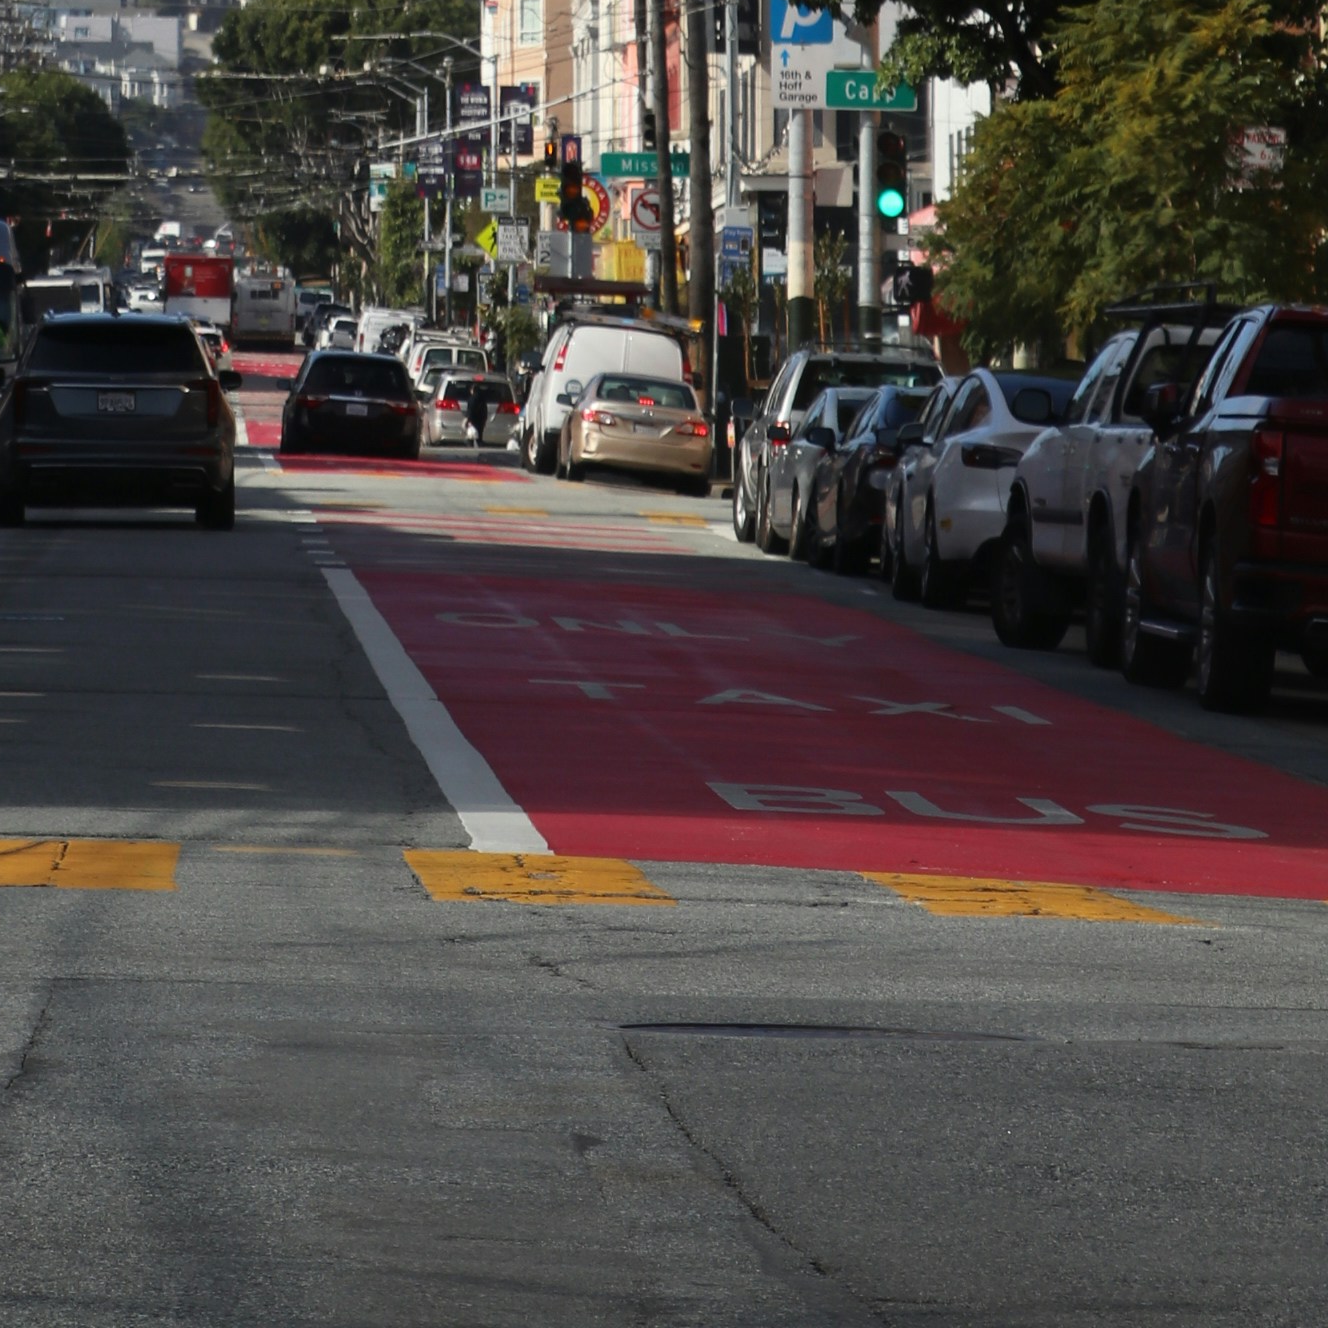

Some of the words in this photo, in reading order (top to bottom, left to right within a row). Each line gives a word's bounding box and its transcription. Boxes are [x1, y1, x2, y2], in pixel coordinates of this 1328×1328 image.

[778, 81, 803, 91] Hoff
[779, 70, 802, 81] 16th
[804, 71, 812, 80] &
[778, 91, 818, 103] Garage
[844, 79, 897, 104] Capp
[435, 612, 862, 648] ONLY
[528, 679, 1052, 726] TAXI
[704, 781, 1271, 841] BUS
